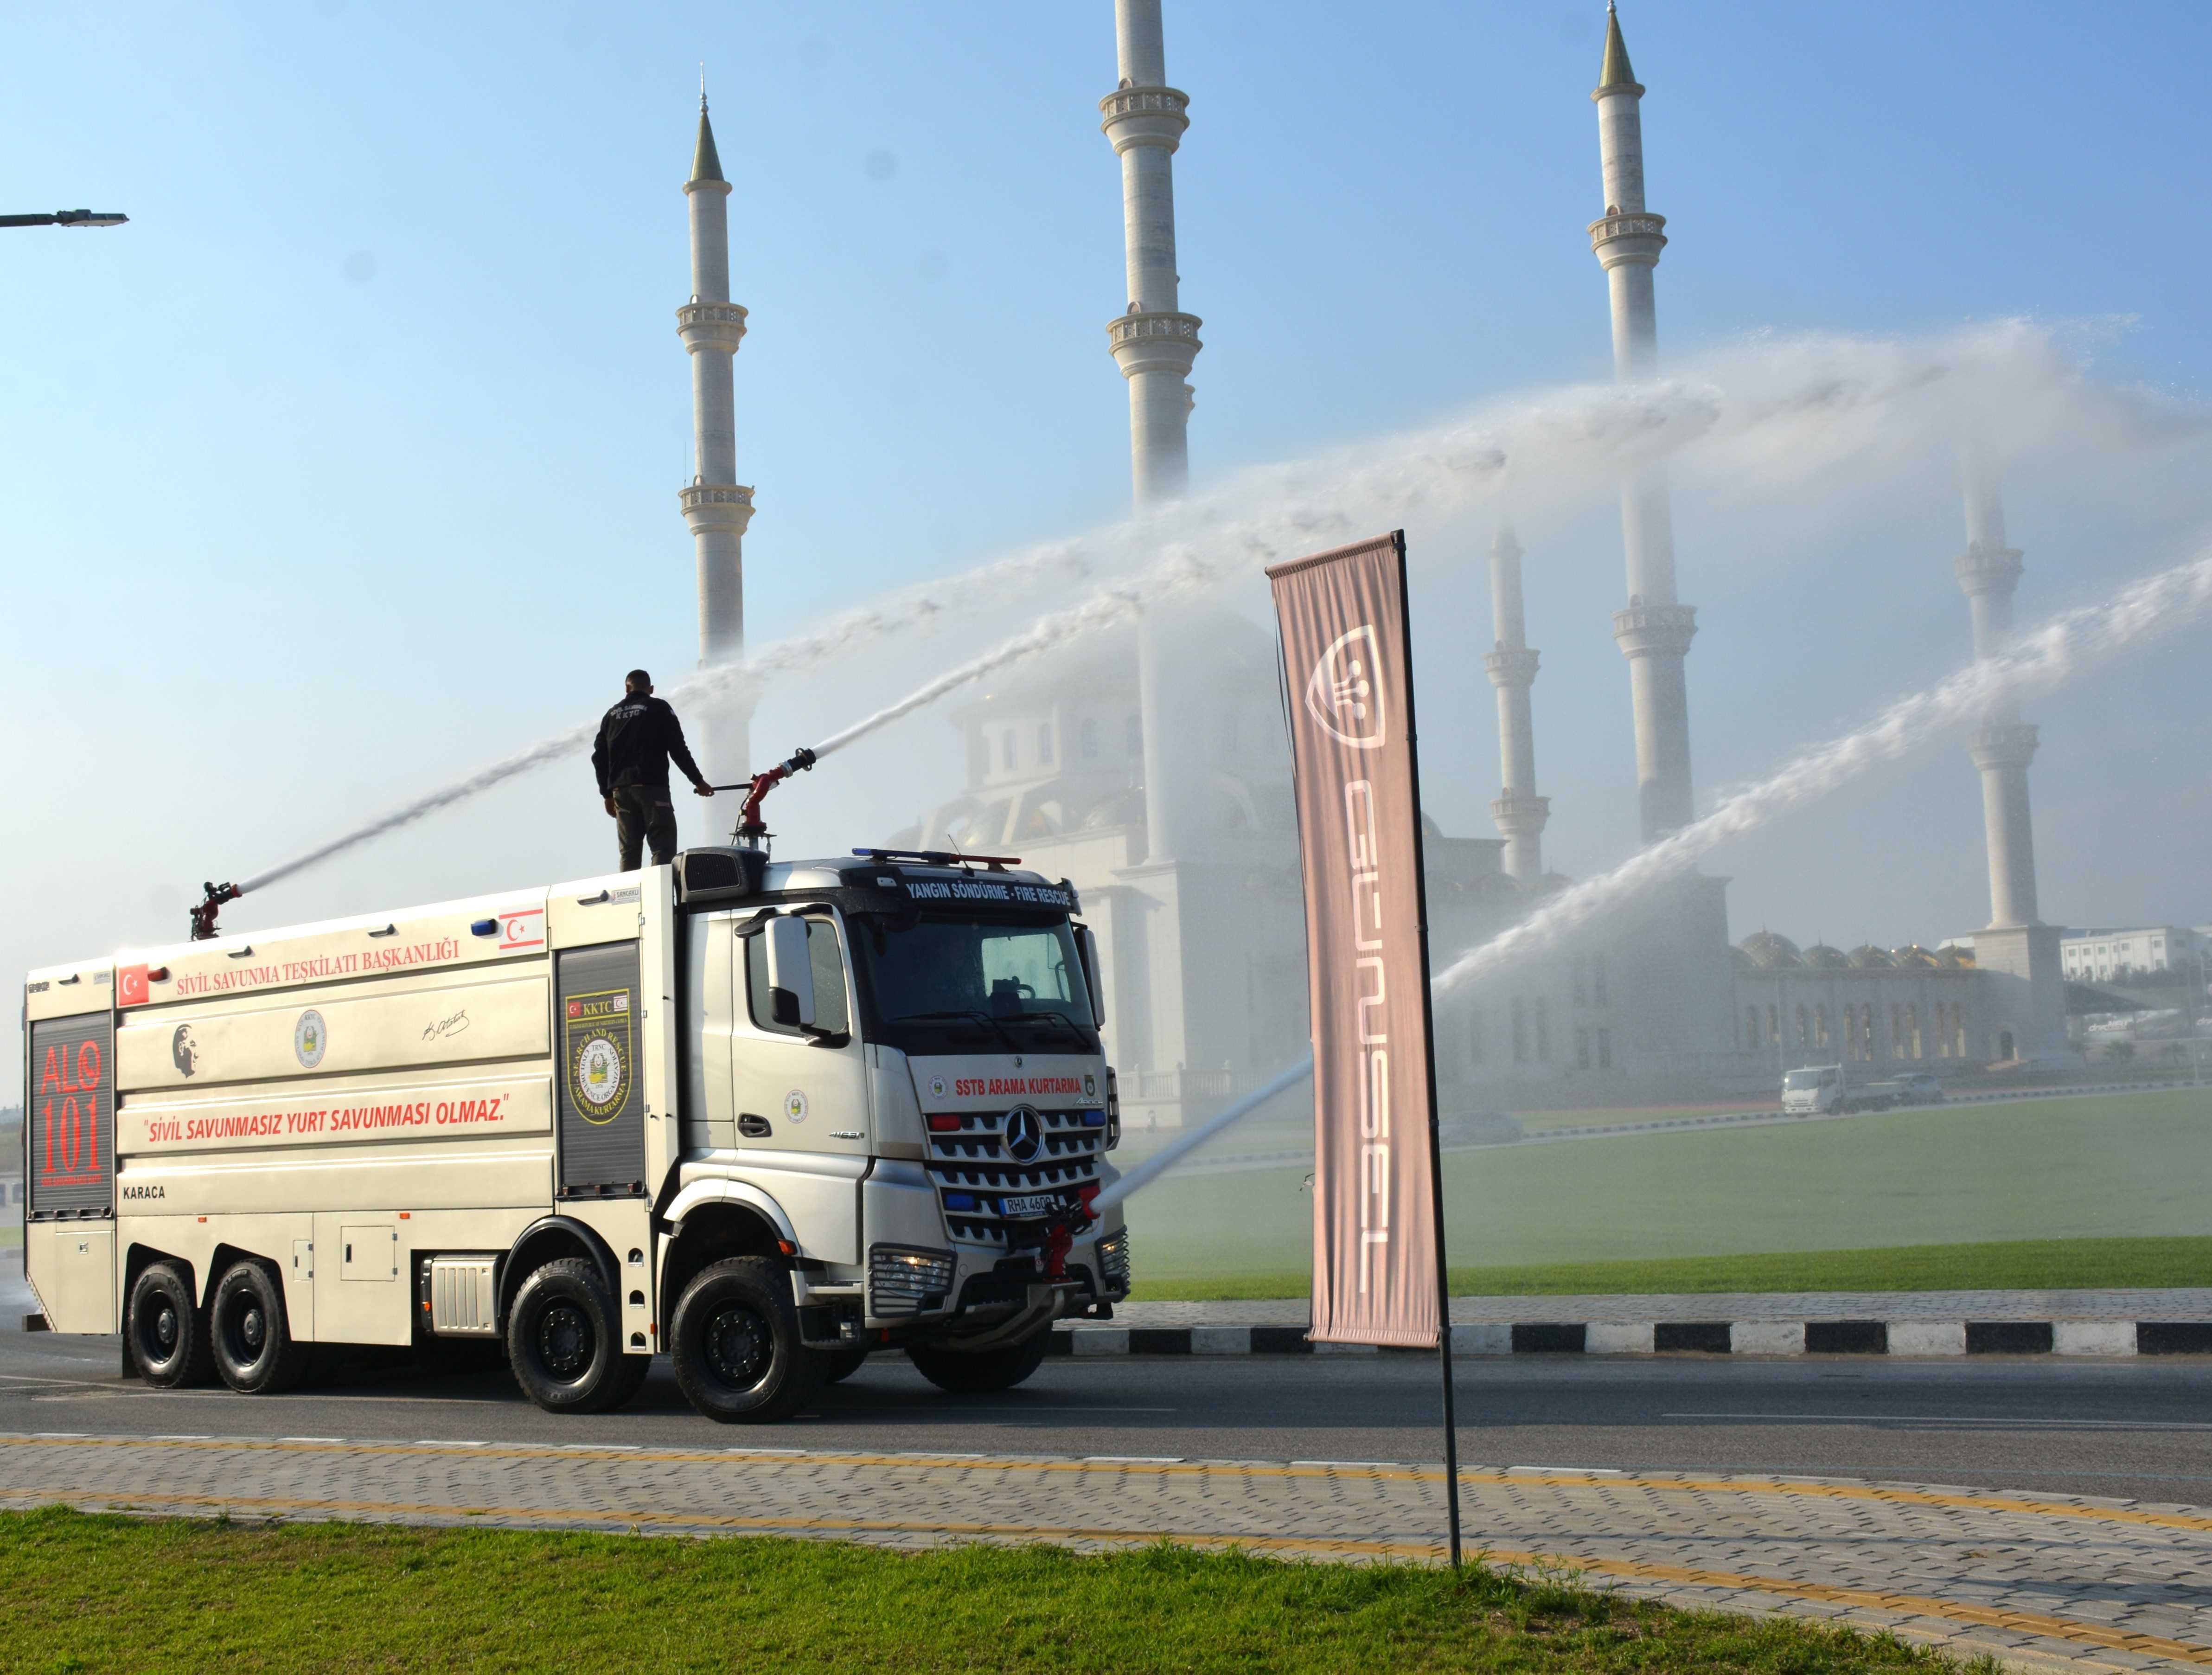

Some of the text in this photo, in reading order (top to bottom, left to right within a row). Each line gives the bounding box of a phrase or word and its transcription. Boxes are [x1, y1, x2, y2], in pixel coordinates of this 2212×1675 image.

[906, 883, 952, 898] YANGIN
[953, 880, 1010, 900] SÖNDÜRME
[1015, 886, 1037, 902] FIRE
[1038, 888, 1071, 906] RESCUE
[177, 937, 460, 995] SİVİL SAVUNMA TEŞKİLATI BAŞKANLIĞI
[583, 1001, 612, 1015] KKTC
[40, 1040, 102, 1096] ALO
[573, 1028, 627, 1077] SEARCH AND RESCUE
[575, 1083, 626, 1115] ARAMA KURTARMA
[955, 1078, 1081, 1096] SSTB ARAMA KURTARMA
[41, 1092, 102, 1173] 101
[186, 1114, 283, 1140] SAVUNMASIZ
[287, 1110, 327, 1134] YURT
[330, 1102, 431, 1131] SAVUNMASI
[123, 1186, 165, 1200] KARACA
[1007, 1198, 1028, 1213] RHA
